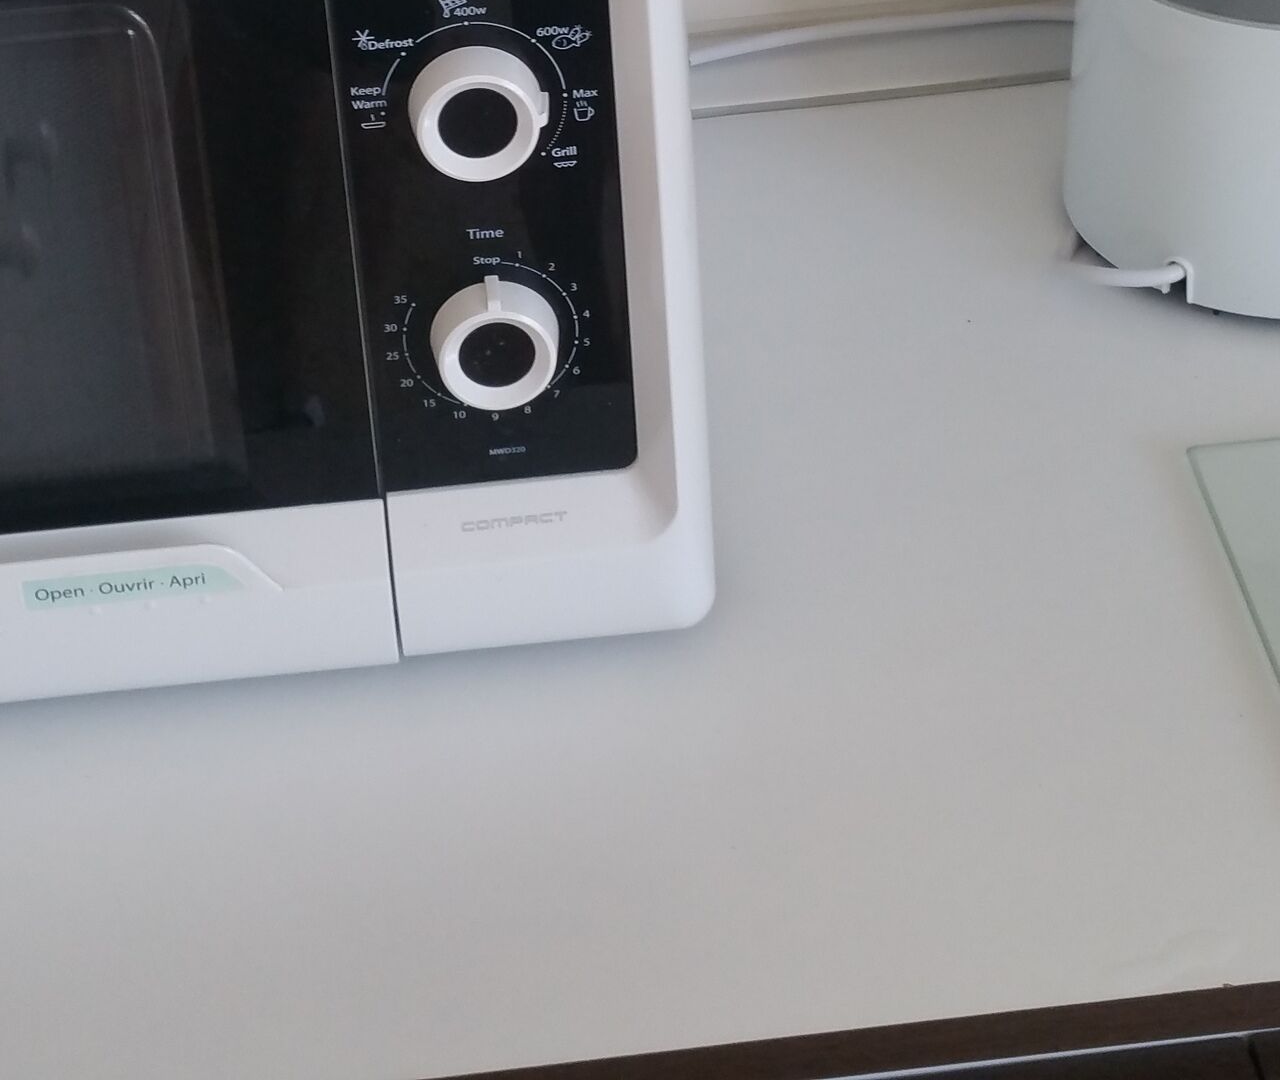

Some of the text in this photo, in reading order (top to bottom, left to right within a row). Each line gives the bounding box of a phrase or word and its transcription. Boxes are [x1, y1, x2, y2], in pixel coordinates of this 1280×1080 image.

[453, 5, 487, 17] 400w
[536, 25, 570, 37] 600w
[368, 37, 415, 50] Defrost
[350, 85, 382, 99] Keep
[572, 87, 599, 99] Max
[351, 99, 388, 111] Warm
[551, 145, 578, 158] Grill
[466, 227, 505, 240] Time
[517, 251, 523, 259] 1
[472, 254, 502, 267] Stop
[548, 263, 556, 271] 2
[570, 283, 578, 292] 3
[394, 295, 408, 304] 35
[582, 310, 591, 318] 4
[384, 324, 398, 333] 30
[583, 338, 591, 347] 5
[386, 352, 400, 361] 25
[573, 366, 581, 375] 6
[400, 379, 414, 388] 20
[553, 390, 561, 399] 7
[423, 399, 437, 408] 15
[524, 405, 532, 414] 8
[453, 410, 467, 420] 10
[491, 412, 500, 421] 9
[462, 510, 568, 532] COMPACT
[34, 572, 207, 603] Open Ouvrir Apri
